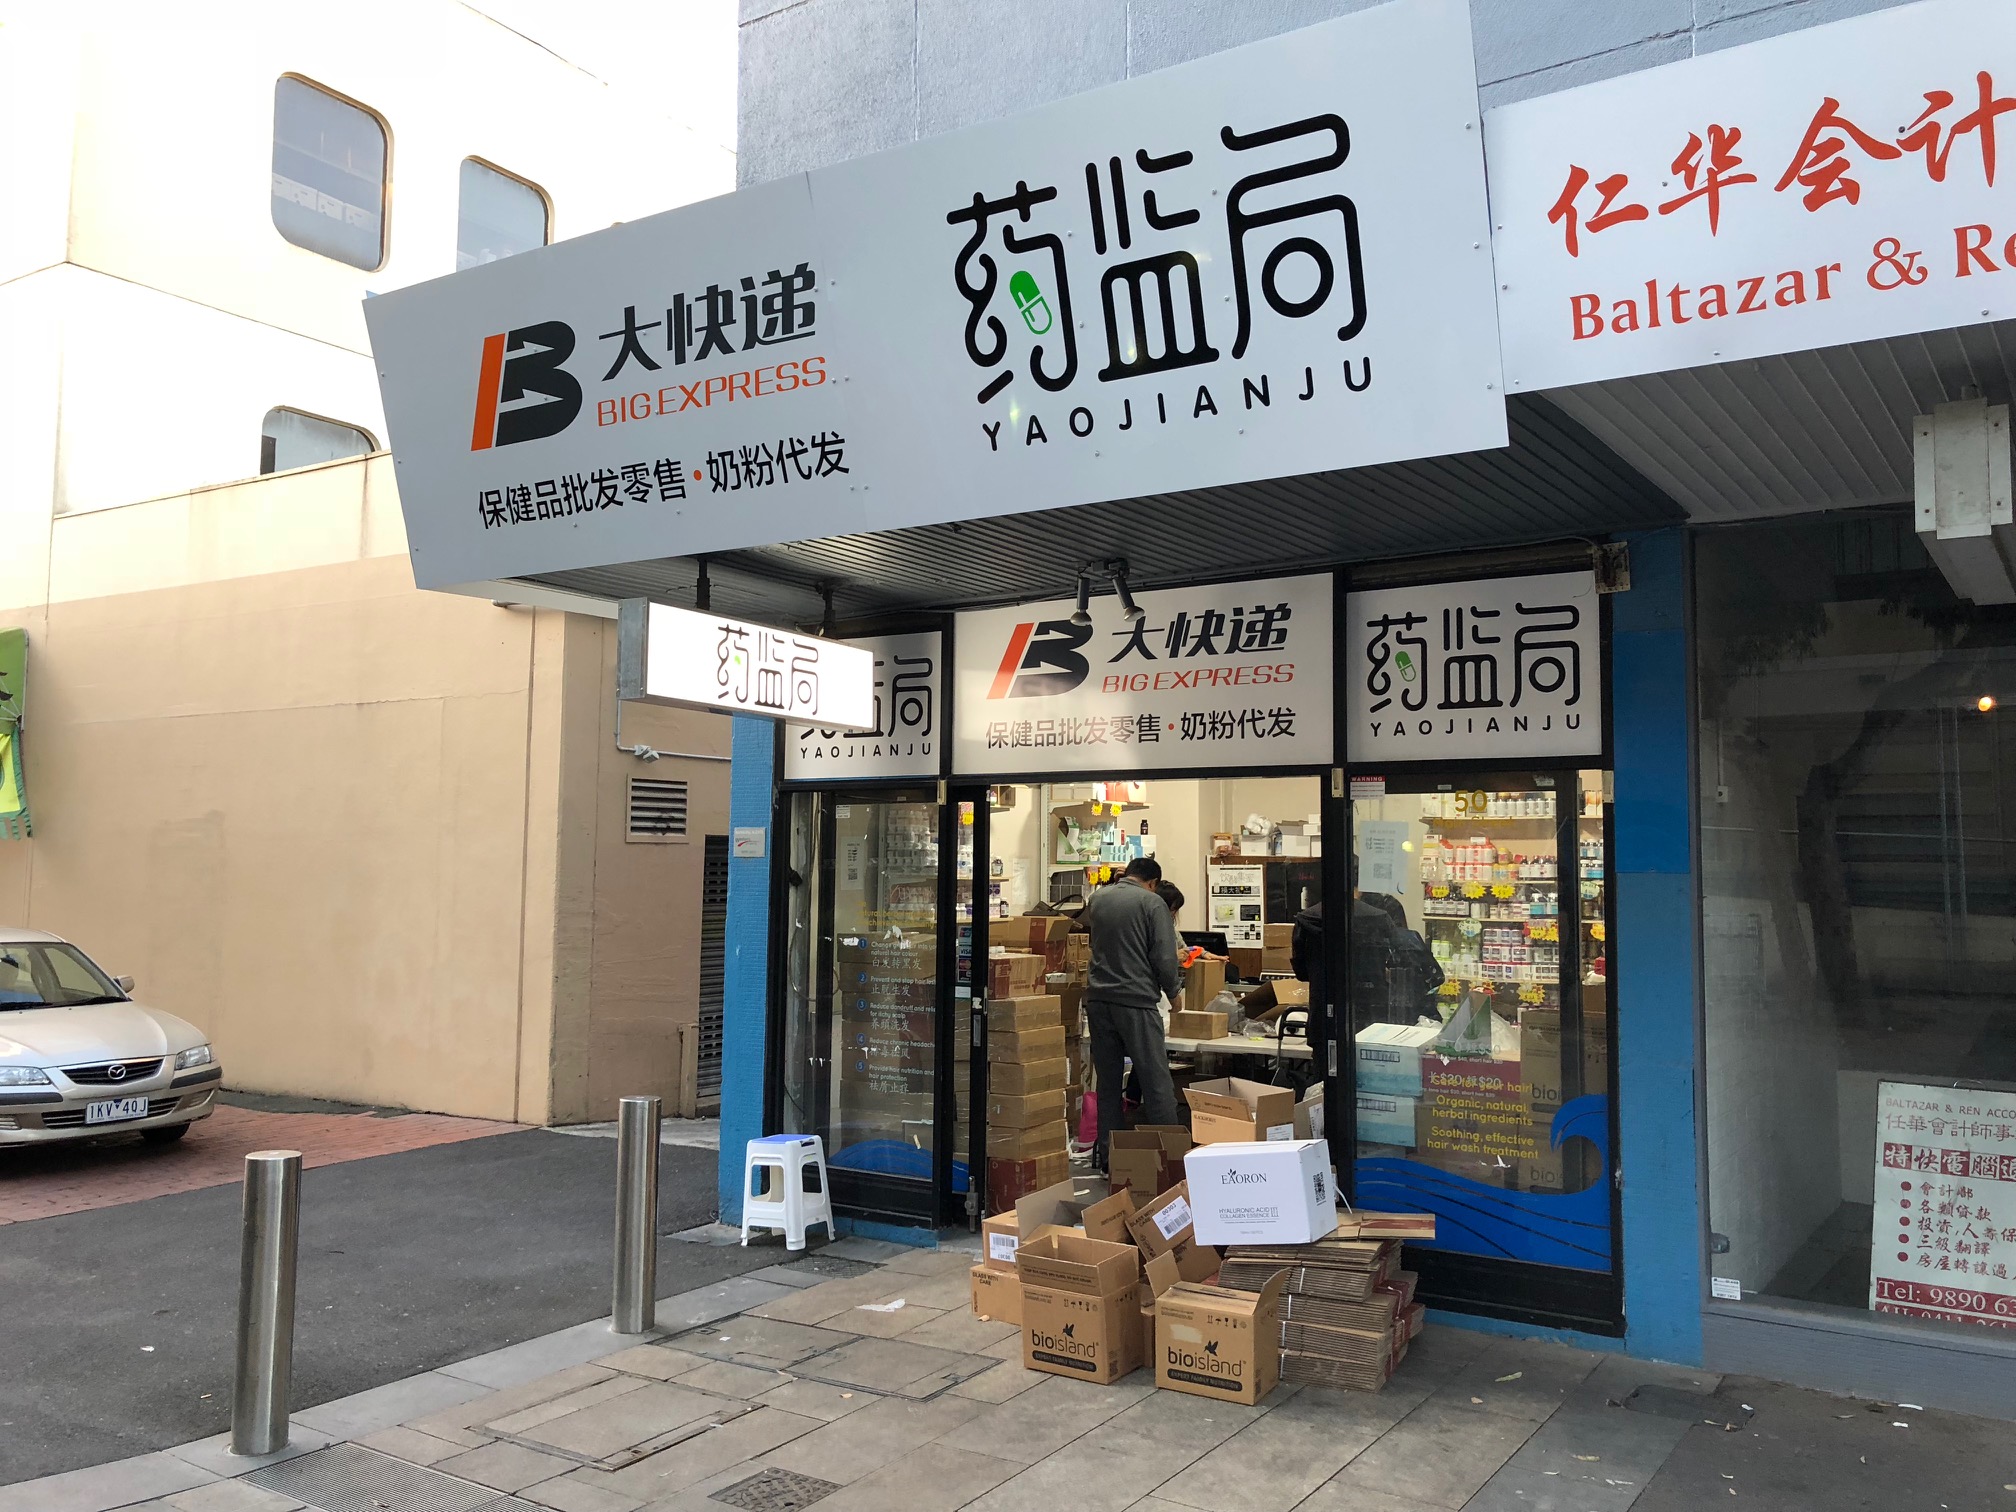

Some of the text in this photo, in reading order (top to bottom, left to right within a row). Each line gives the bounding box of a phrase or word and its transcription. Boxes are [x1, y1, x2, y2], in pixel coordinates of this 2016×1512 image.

[1547, 70, 2016, 258] 仁华会计
[947, 113, 1368, 405] 药监局
[1569, 262, 1841, 341] Baltazar
[1866, 237, 1929, 291] &
[599, 262, 816, 381] 大快递
[658, 356, 826, 415] EXPRESS
[982, 356, 1371, 452] YAOJIANJU
[1107, 602, 1292, 663] 大快递
[717, 624, 818, 716] 药监局
[1366, 602, 1580, 713] 药监局
[1153, 663, 1295, 691] EXPRESS
[1370, 714, 1580, 737] YAOJIANJU
[800, 742, 931, 759] YAOJIANJU
[1455, 790, 1488, 812] 50
[1432, 1108, 1533, 1126] herbal ingredients
[1437, 1095, 1529, 1114] Organic, natural,
[1886, 1098, 2016, 1119] BALTAZAR & REN ACCO
[1432, 1126, 1534, 1146] Soothing, effective
[1886, 1112, 2016, 1142] 任華會計師事
[1427, 1138, 1538, 1159] hair wash treatment
[1221, 1172, 1268, 1185] EAORON
[1916, 1252, 2016, 1280] 房屋轉讓過
[1878, 1281, 1920, 1302] Tel:
[1930, 1288, 1986, 1311] 9890
